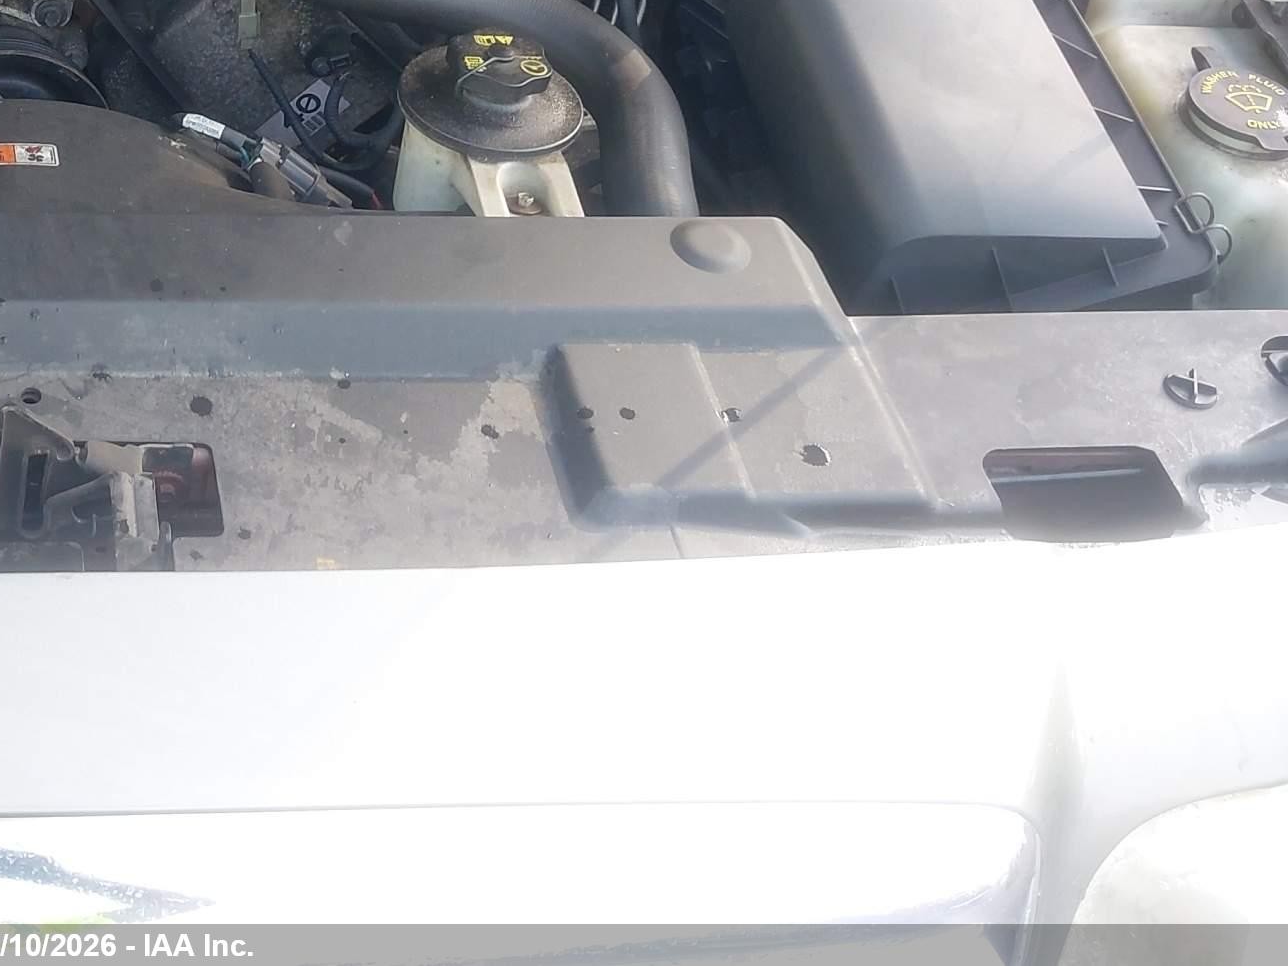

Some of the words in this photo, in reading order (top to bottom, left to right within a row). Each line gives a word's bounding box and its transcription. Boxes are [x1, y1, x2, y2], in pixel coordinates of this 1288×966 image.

[1201, 70, 1240, 94] WASHER
[1248, 74, 1286, 96] FLUID
[1247, 119, 1281, 130] ONLY
